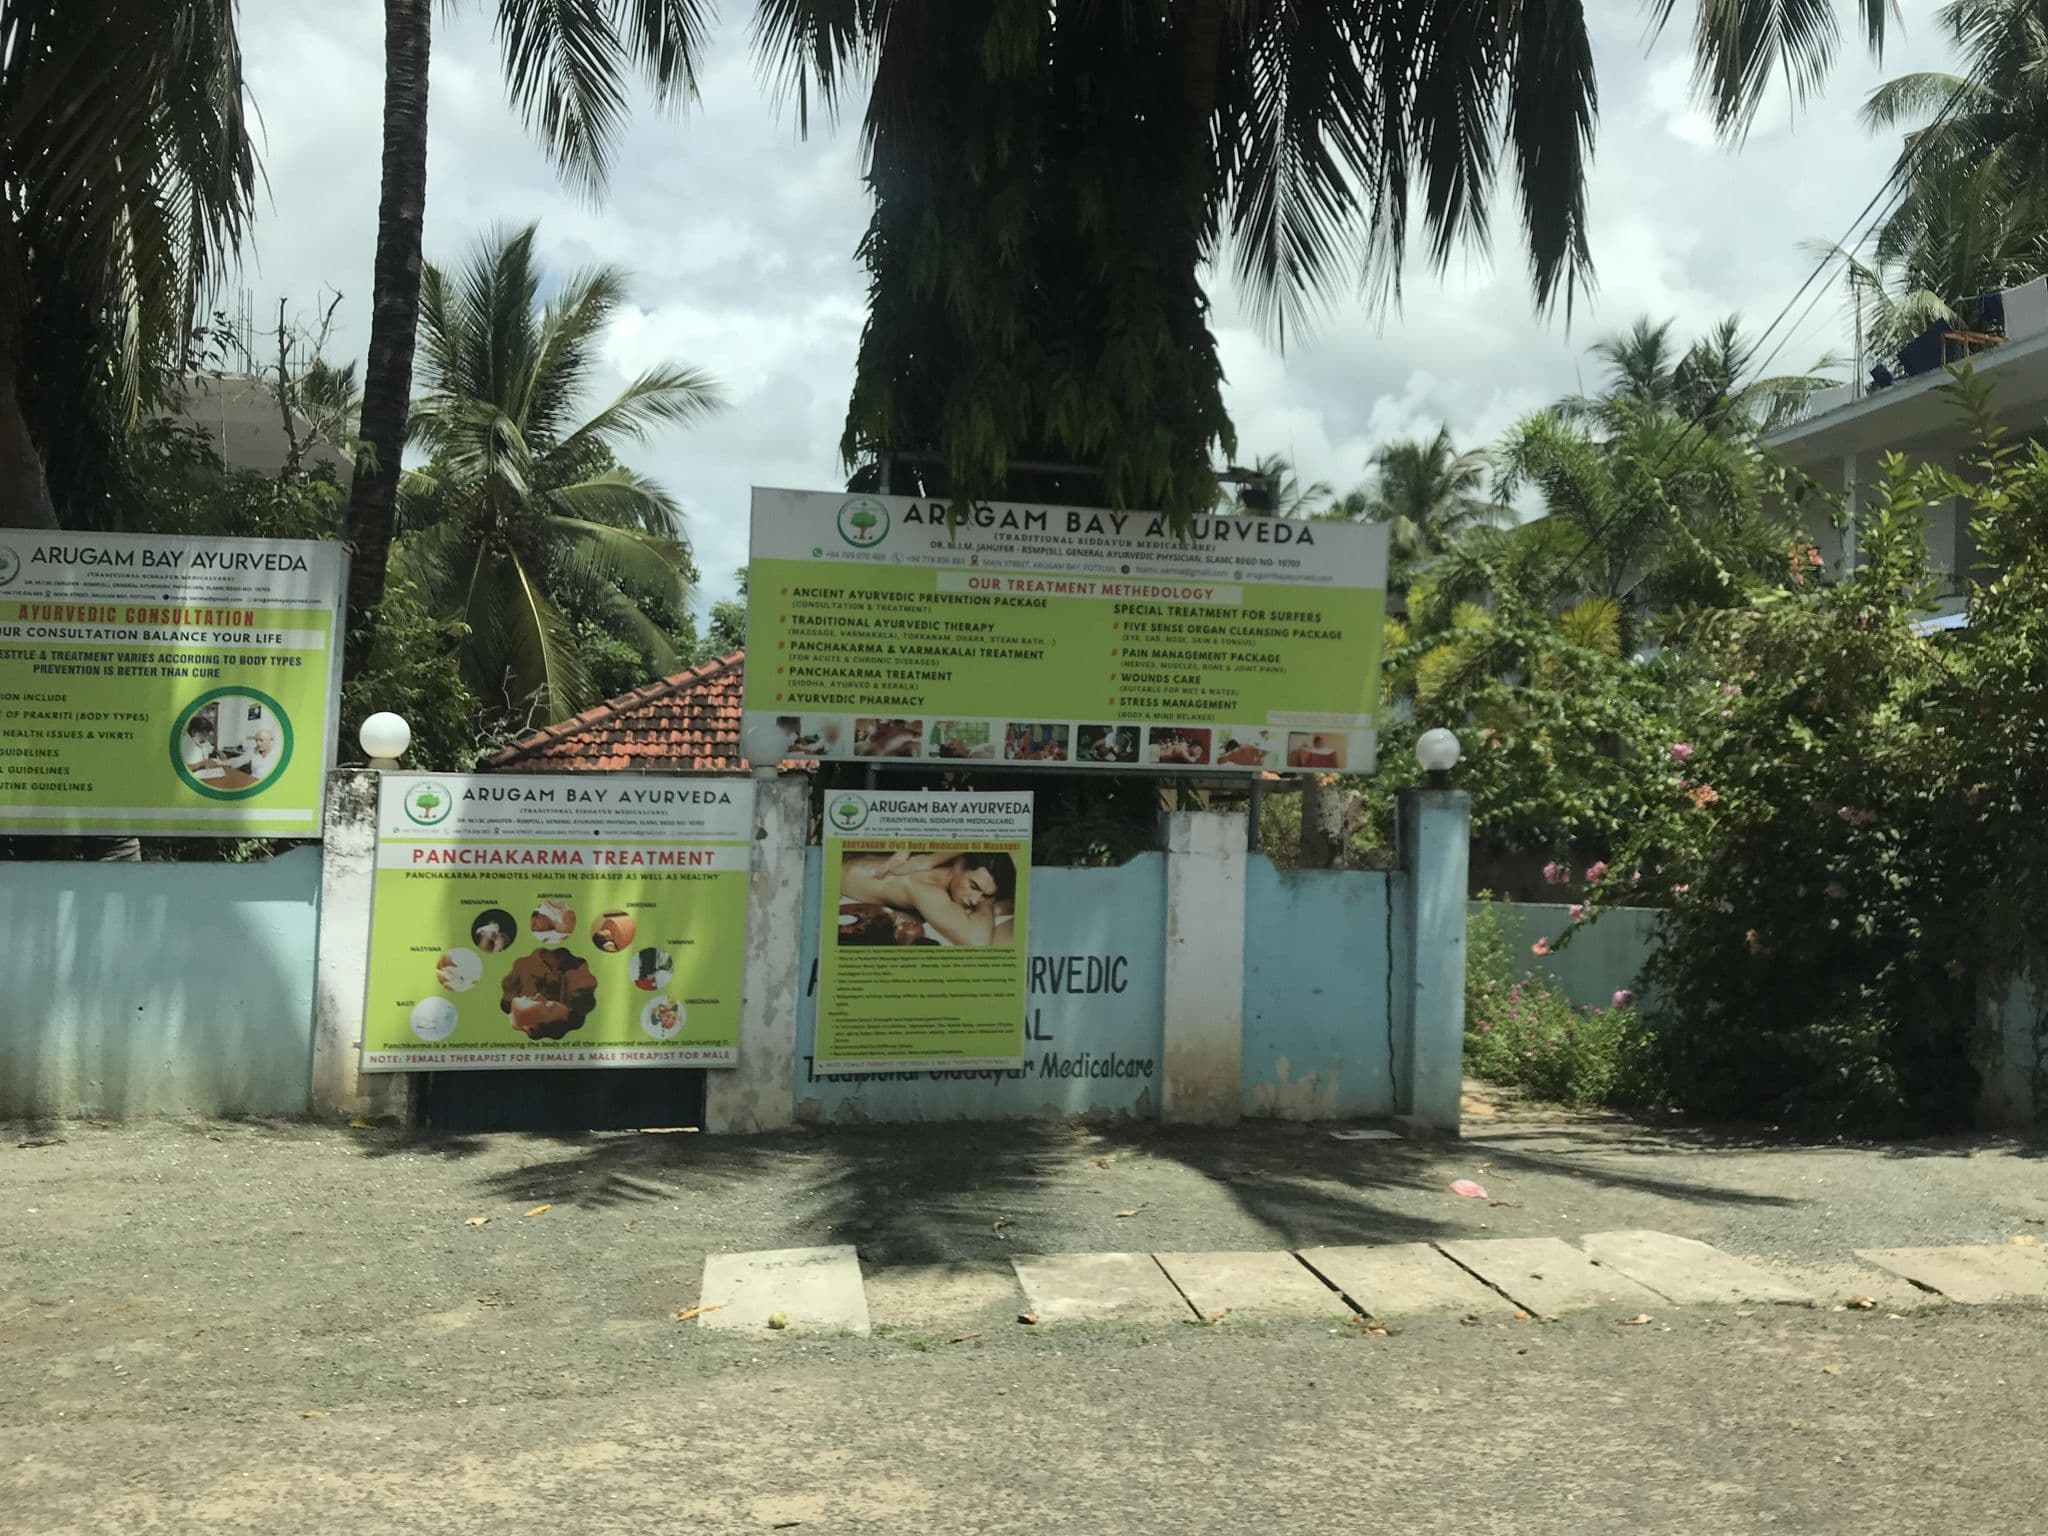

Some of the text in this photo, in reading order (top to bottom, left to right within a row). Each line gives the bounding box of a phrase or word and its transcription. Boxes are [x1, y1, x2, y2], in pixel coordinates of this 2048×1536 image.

[1066, 511, 1130, 535] BAY
[1146, 517, 1316, 545] AURVEDA
[31, 547, 308, 573] ARUGAM BAY AYURVEDA
[968, 577, 1214, 600] OUR TREATMENT METHEDOLOGY
[793, 588, 1048, 608] ANCIENT AYURVEDIC PREVENTION PACKAGE
[18, 604, 255, 627] AYURVEDIC CONSULTATION
[1113, 604, 1322, 623] SPECIAL TREATMENT FOR SURFERS
[792, 616, 994, 633] TRADITIONAL AYURVEDIC THERAPY
[1123, 622, 1343, 641] FIVE SENSE ORGAN CLEANSING PACKAGE
[26, 627, 137, 641] CONSULTATION
[143, 630, 207, 642] BALANCE
[213, 632, 250, 644] YOUR
[255, 633, 282, 645] LIFE
[791, 641, 1044, 660] PANCHAKARMA & VARMAKALAI TREATMENT
[1122, 648, 1281, 664] PAIN MANAGEMENT PACKAGE
[39, 651, 48, 662] &
[51, 651, 114, 663] TREATMENT
[118, 652, 155, 664] VARIES
[159, 653, 220, 665] ACCORDING
[224, 655, 236, 665] TO
[240, 655, 266, 666] BODY
[270, 656, 302, 667] TYPES
[33, 664, 221, 679] PREVENTION IS BETTER THAN CURE
[789, 667, 952, 682] PANCHAKARMA TREATMENT
[1121, 673, 1201, 685] WOUNDS CARE
[23, 694, 67, 703] INCLUDE
[788, 693, 925, 707] AYURVEDIC PHARMACY
[1120, 697, 1238, 711] STRESS MANAGEMENT
[5, 710, 149, 723] OF PRAKRITI (BODY TYPES)
[2, 729, 43, 739] HEALTH
[46, 730, 83, 740] ISSUES
[86, 731, 95, 740] &
[8, 766, 71, 776] GUIDELINES
[31, 782, 94, 793] GUIDELINES
[463, 787, 732, 806] ARUGAM BAY AYURVEDA
[870, 800, 1030, 815] ARUGAM BAY AYURVEDA
[412, 848, 716, 866] PANCHAKARMA TREATMENT
[405, 872, 478, 880] PANCHAKARMA
[480, 872, 530, 881] PROMOTES
[532, 872, 566, 881] HEALTH
[568, 872, 578, 881] IN
[625, 873, 637, 881] AS
[641, 873, 664, 881] WELL
[666, 873, 678, 881] AS
[680, 872, 719, 882] HEALTHY
[1027, 956, 1128, 994] RVEDIC
[406, 1054, 446, 1064] FEMALE
[450, 1054, 506, 1064] THERAPIST
[509, 1053, 530, 1063] FOR
[534, 1053, 574, 1062] FEMALE
[578, 1053, 586, 1062] &
[589, 1053, 617, 1062] MALE
[620, 1052, 675, 1062] THERAPIST
[679, 1051, 699, 1060] FOR
[702, 1051, 731, 1060] MALE
[1040, 1052, 1153, 1079] Medicalcare
